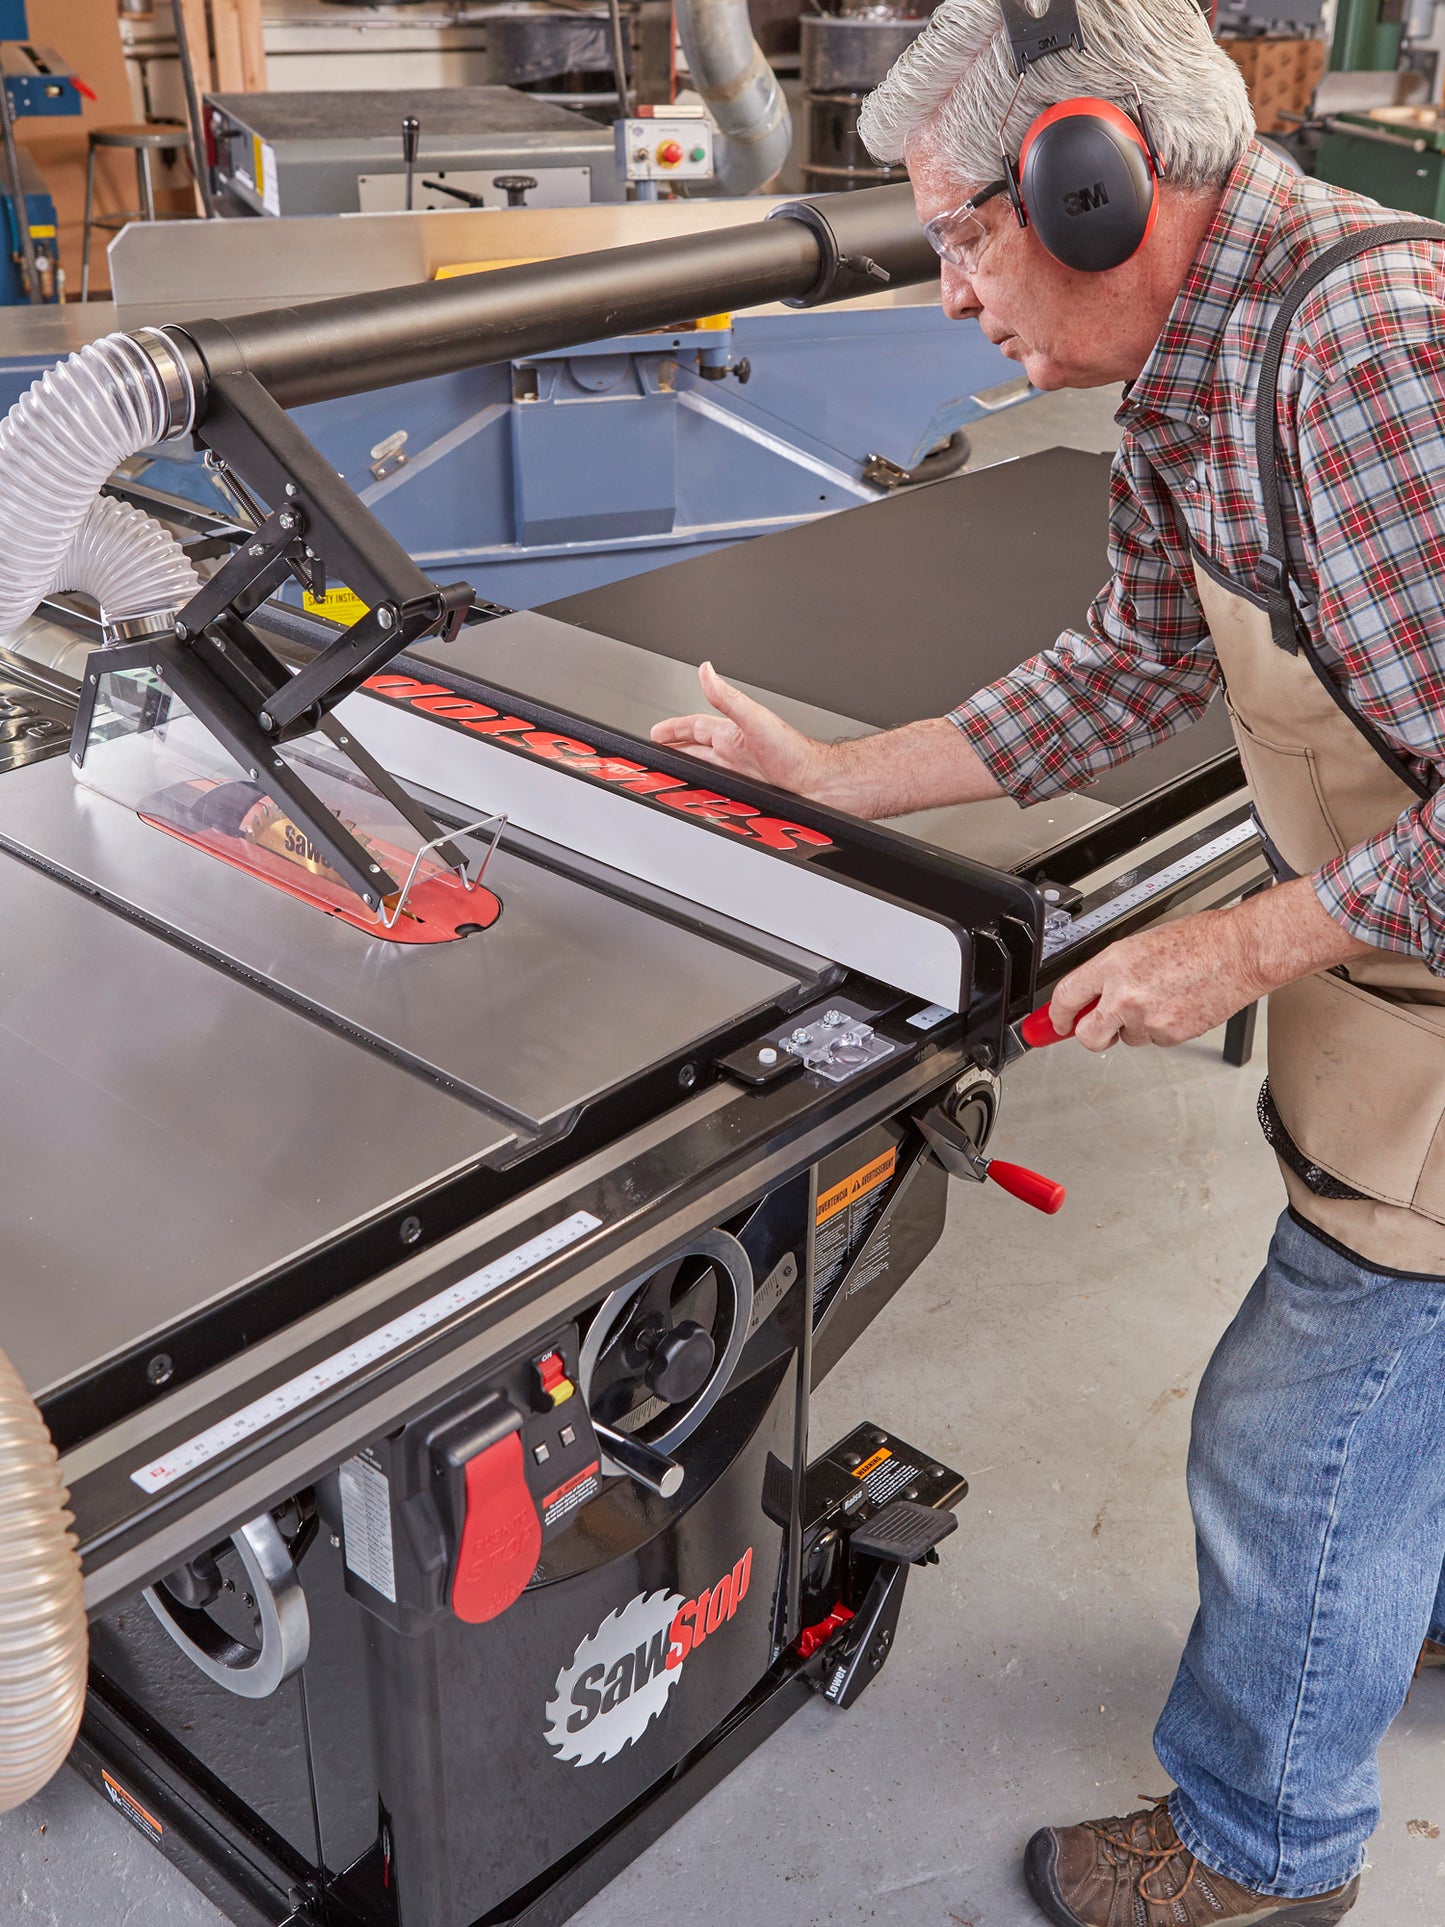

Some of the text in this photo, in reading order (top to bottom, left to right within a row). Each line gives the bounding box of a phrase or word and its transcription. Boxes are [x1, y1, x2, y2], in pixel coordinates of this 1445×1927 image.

[1038, 36, 1058, 50] 3M
[1063, 181, 1110, 217] 3M
[465, 1523, 534, 1583] STOP
[566, 1546, 753, 1734] SawStop
[825, 1666, 847, 1698] Lower
